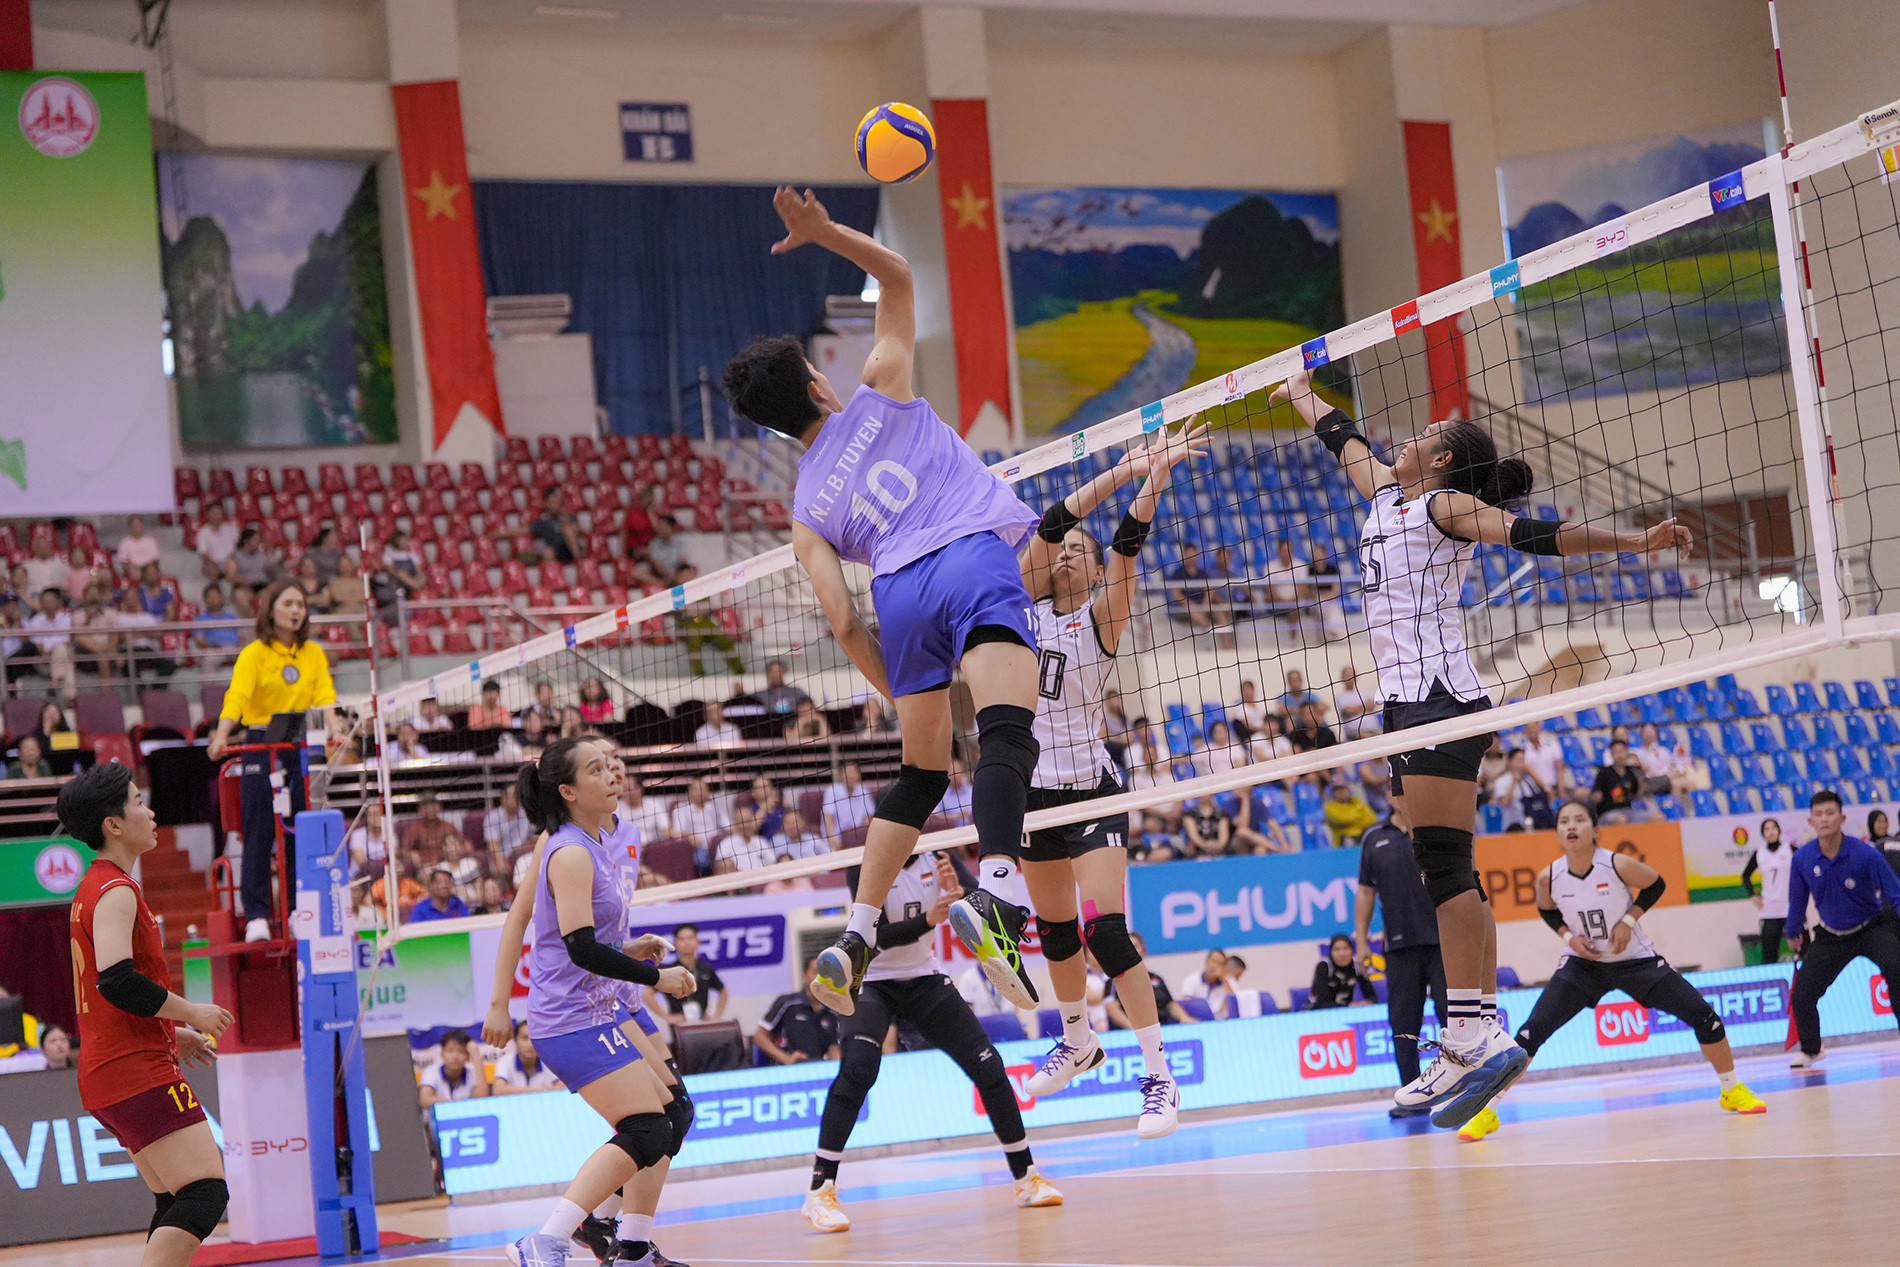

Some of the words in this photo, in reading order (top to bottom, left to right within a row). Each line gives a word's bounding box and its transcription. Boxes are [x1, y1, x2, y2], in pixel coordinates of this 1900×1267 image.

[1871, 108, 1898, 123] Senoh
[1596, 229, 1626, 249] BYD
[809, 415, 884, 524] N.T.B.TUYEN
[852, 459, 918, 536] 10
[1577, 908, 1609, 940] 19
[597, 1027, 629, 1056] 14
[1302, 1039, 1353, 1071] ON
[167, 1082, 199, 1113] 12
[251, 1138, 308, 1156] BYD
